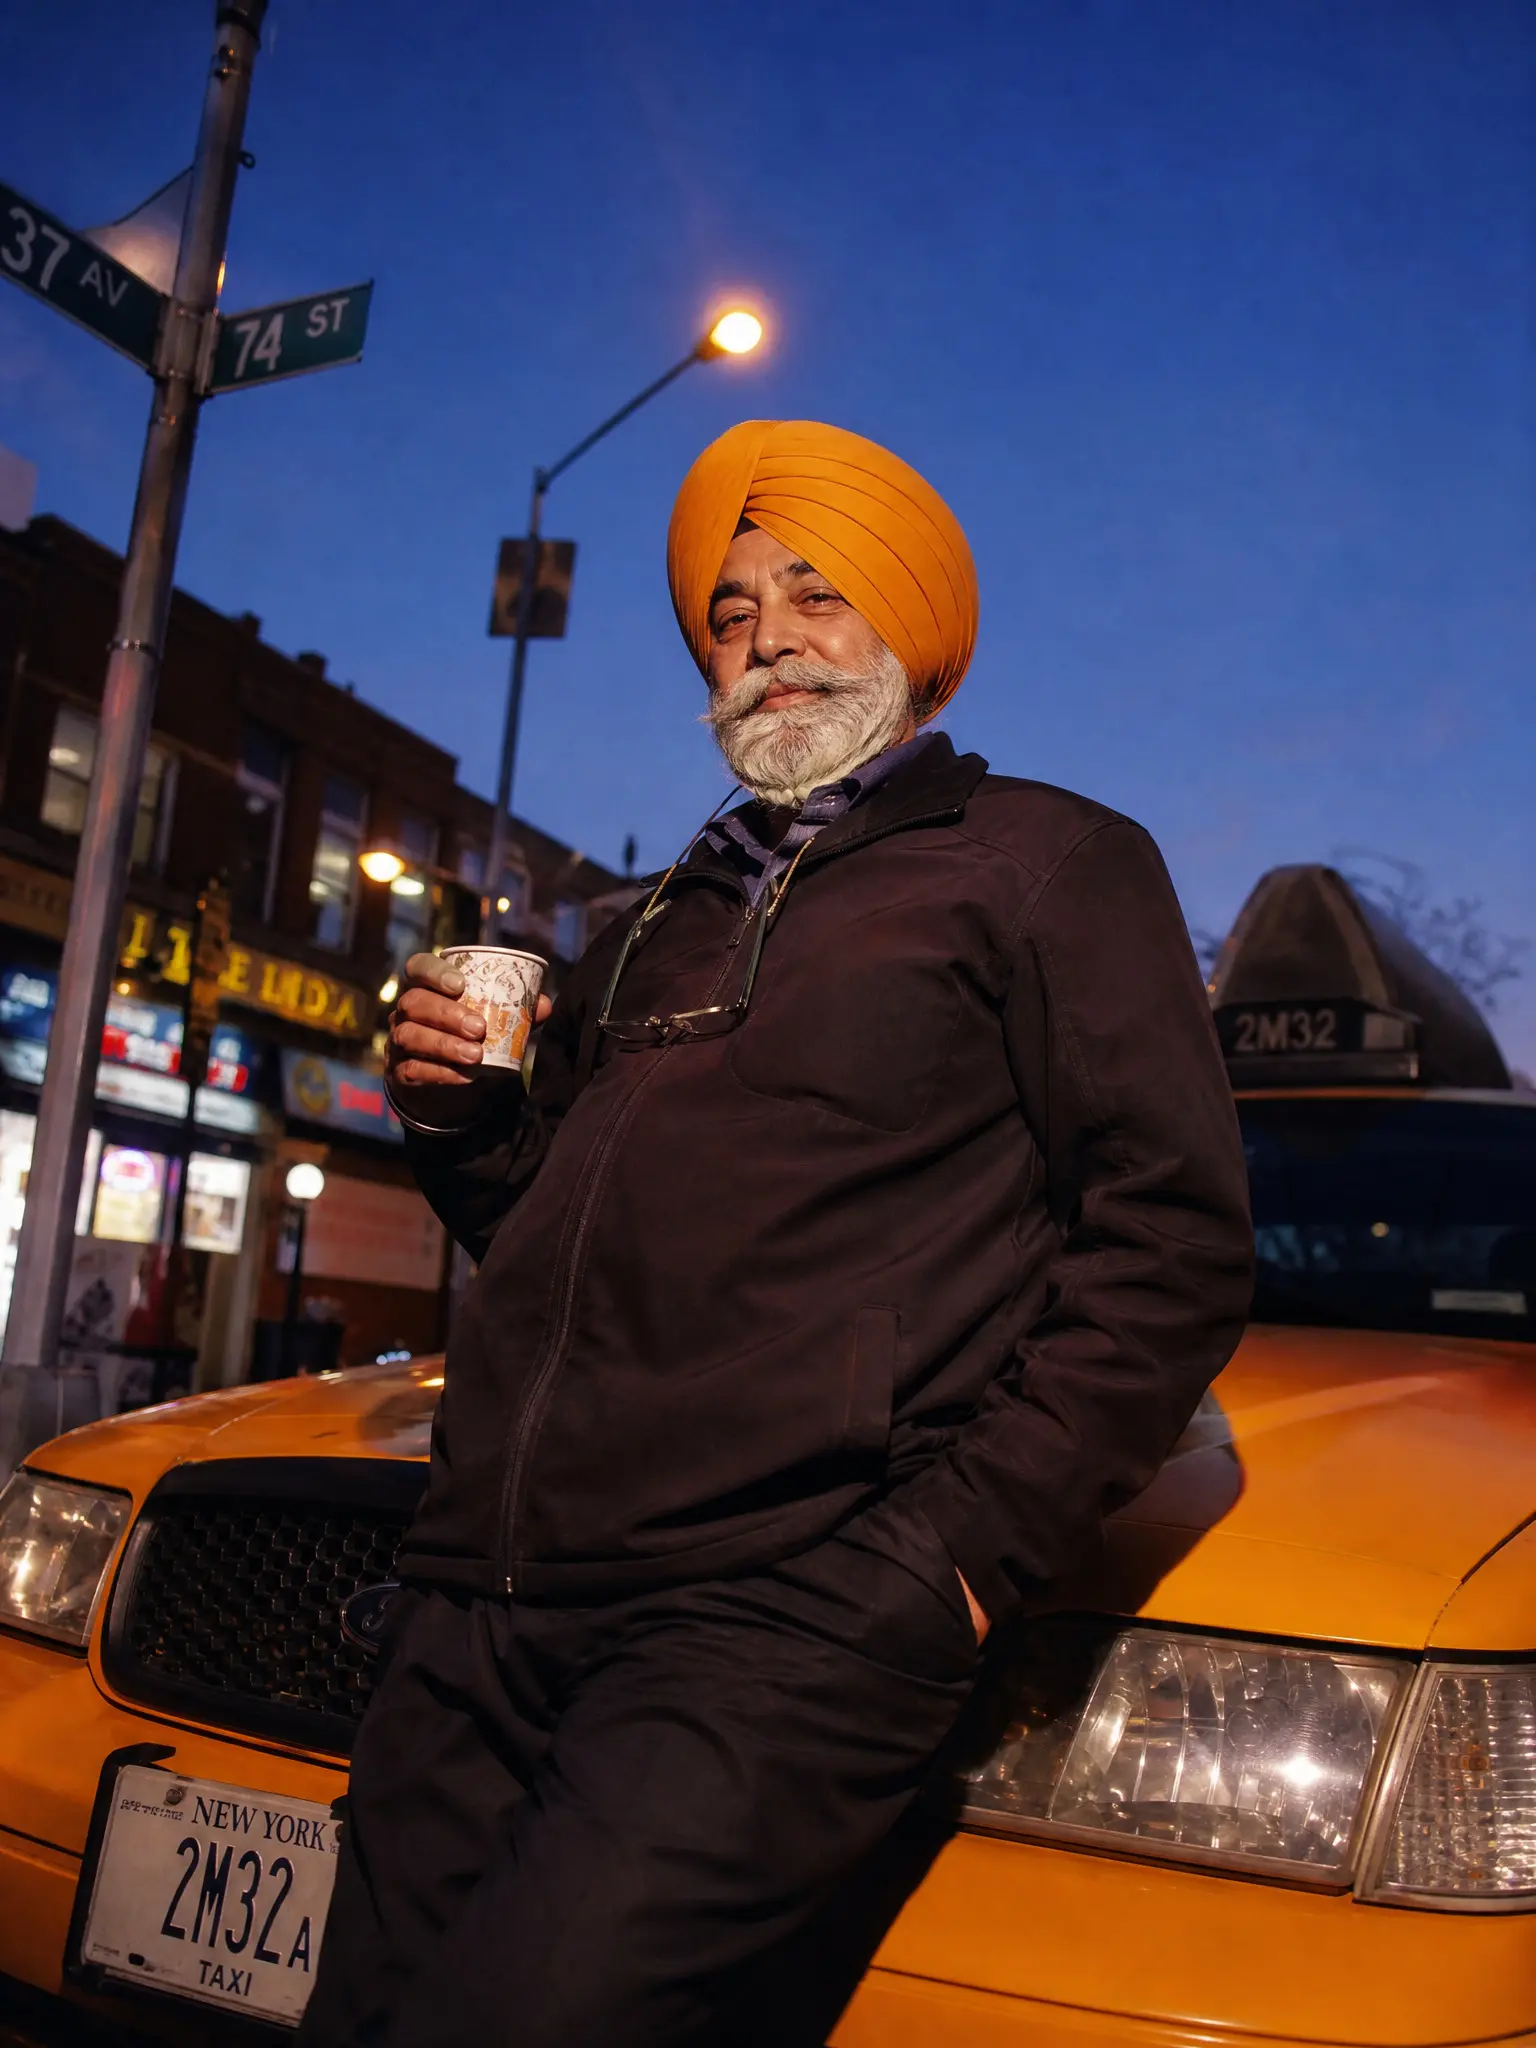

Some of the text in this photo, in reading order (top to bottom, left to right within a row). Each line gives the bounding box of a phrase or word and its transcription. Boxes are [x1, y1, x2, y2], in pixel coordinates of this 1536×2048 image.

[1, 206, 129, 307] 37 AV
[234, 298, 350, 378] 74 ST
[1234, 1010, 1336, 1051] 2M32
[191, 1795, 258, 1835] NEW
[263, 1811, 328, 1852] YORK
[200, 1959, 253, 1997] TAXI
